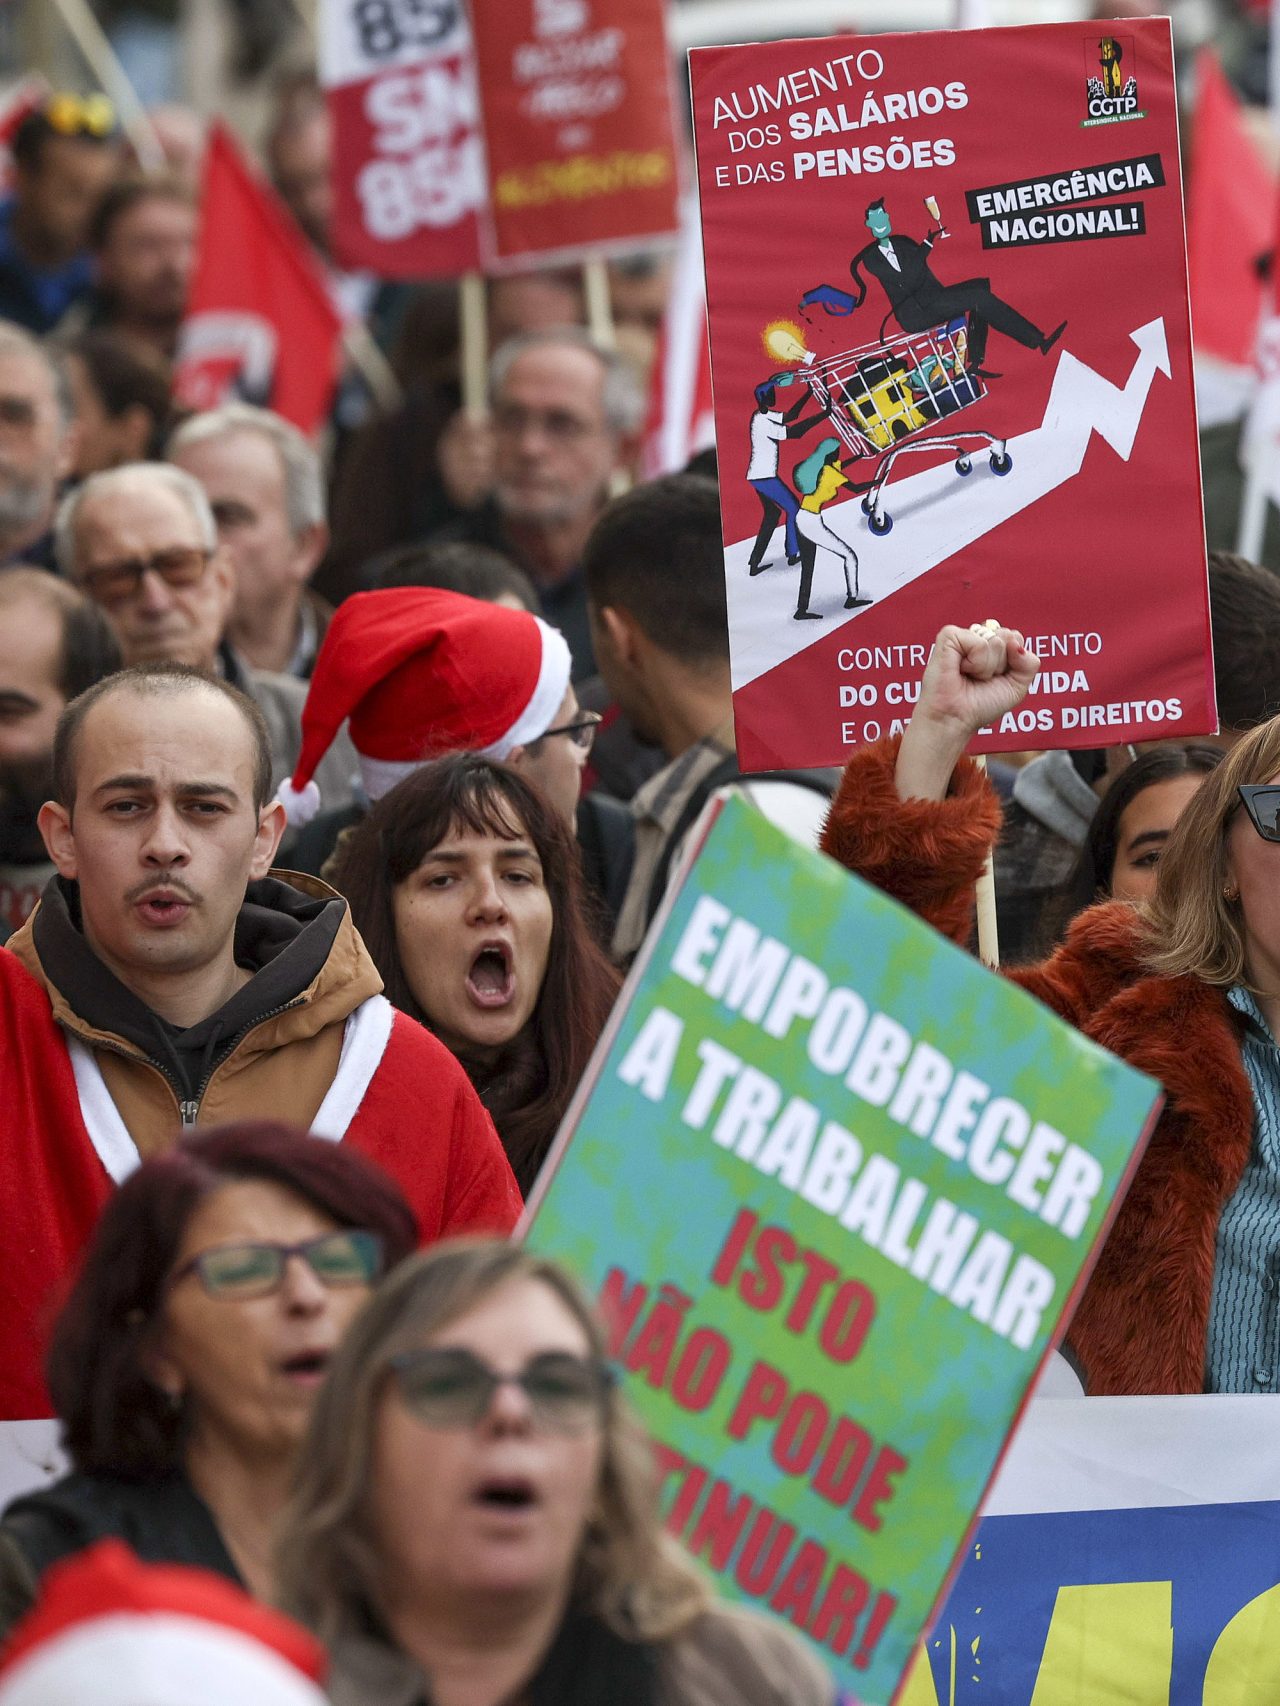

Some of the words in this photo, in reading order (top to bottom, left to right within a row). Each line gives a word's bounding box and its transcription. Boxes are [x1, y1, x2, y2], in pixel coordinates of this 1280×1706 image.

[713, 49, 884, 129] AUMENTO
[728, 124, 782, 153] DOS
[788, 82, 969, 141] SALÁRIOS
[1089, 97, 1136, 116] CGTP
[715, 166, 731, 187] E
[736, 161, 785, 185] DAS
[793, 136, 956, 179] PENSÕES
[975, 162, 1155, 217] EMERGÊNCIA
[988, 207, 1139, 243] NACIONAL!
[839, 684, 878, 707] DO
[1028, 670, 1089, 695] VIDA
[842, 722, 857, 744] E
[863, 720, 881, 742] O
[999, 707, 1054, 734] AOS
[1060, 698, 1182, 729] DIREITOS
[670, 894, 1103, 1241] EMPOBRECER
[616, 1006, 685, 1102] A
[682, 1040, 1056, 1352] TRABALHAR
[710, 1207, 877, 1365] ISTO
[599, 1266, 734, 1413] NÃO
[727, 1361, 909, 1533] PODE
